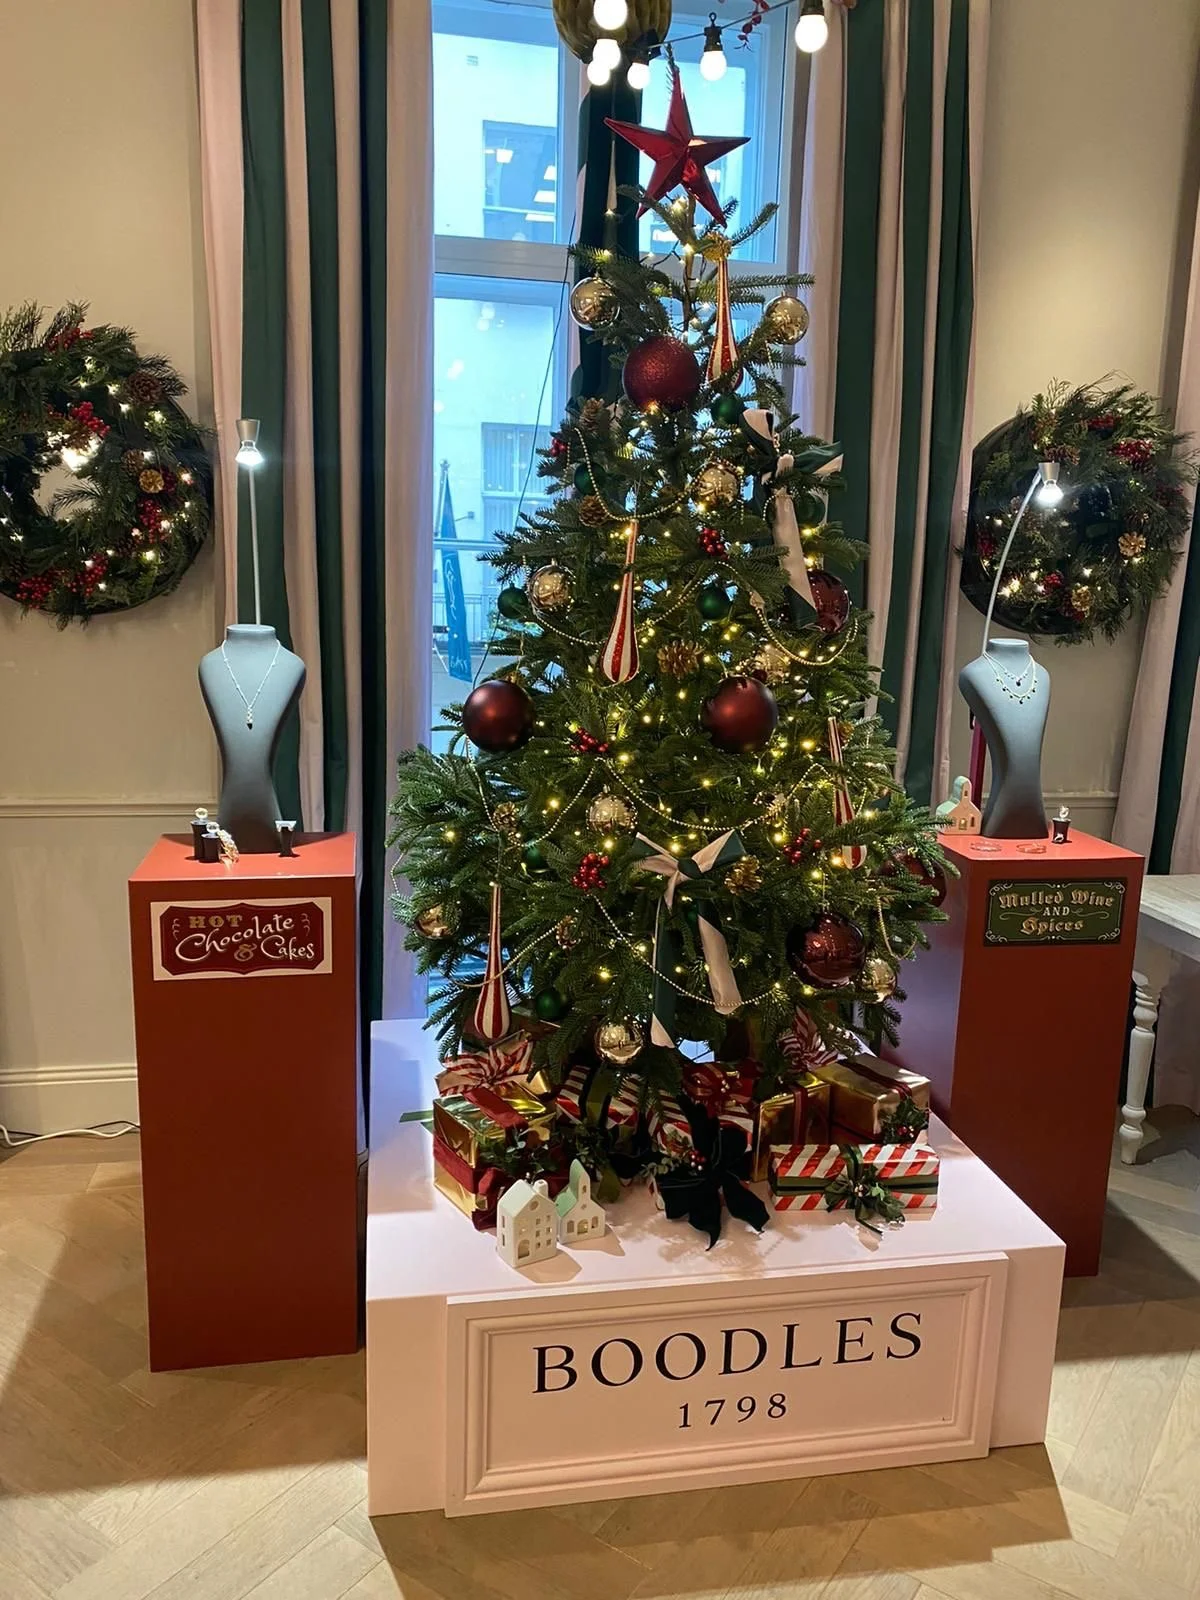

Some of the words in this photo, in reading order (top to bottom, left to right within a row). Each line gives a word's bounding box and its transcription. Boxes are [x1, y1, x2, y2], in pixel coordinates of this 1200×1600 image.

[999, 890, 1064, 909] Mulled
[1071, 889, 1115, 907] Wine
[188, 914, 243, 929] HOT
[1042, 906, 1070, 917] AND
[175, 913, 295, 962] Chocolate
[1020, 916, 1084, 935] Spices
[233, 943, 258, 962] &
[260, 934, 315, 961] Cakes
[531, 1312, 922, 1394] BOODLES
[678, 1392, 788, 1429] 1798
